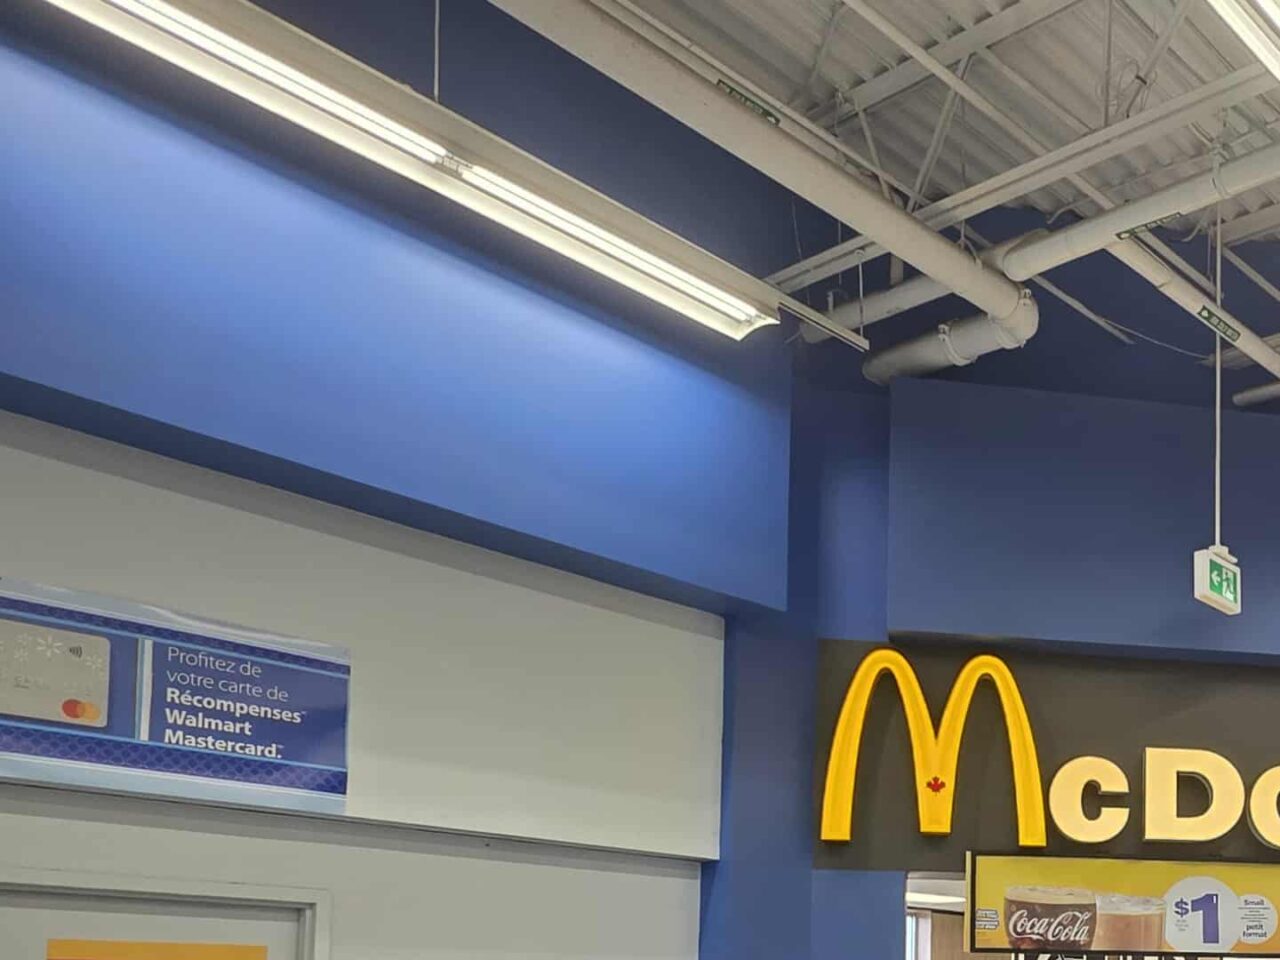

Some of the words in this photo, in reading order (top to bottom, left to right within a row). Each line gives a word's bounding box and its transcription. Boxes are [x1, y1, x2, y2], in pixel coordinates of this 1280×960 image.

[167, 646, 235, 673] Profitez
[239, 661, 262, 678] de
[166, 671, 215, 690] votre
[218, 677, 263, 698] carte
[266, 684, 289, 703] de
[165, 707, 253, 736] Walmart
[166, 687, 302, 724] Récompenses
[164, 728, 283, 759] Mastercard.
[1008, 909, 1093, 942] Coca-Cola
